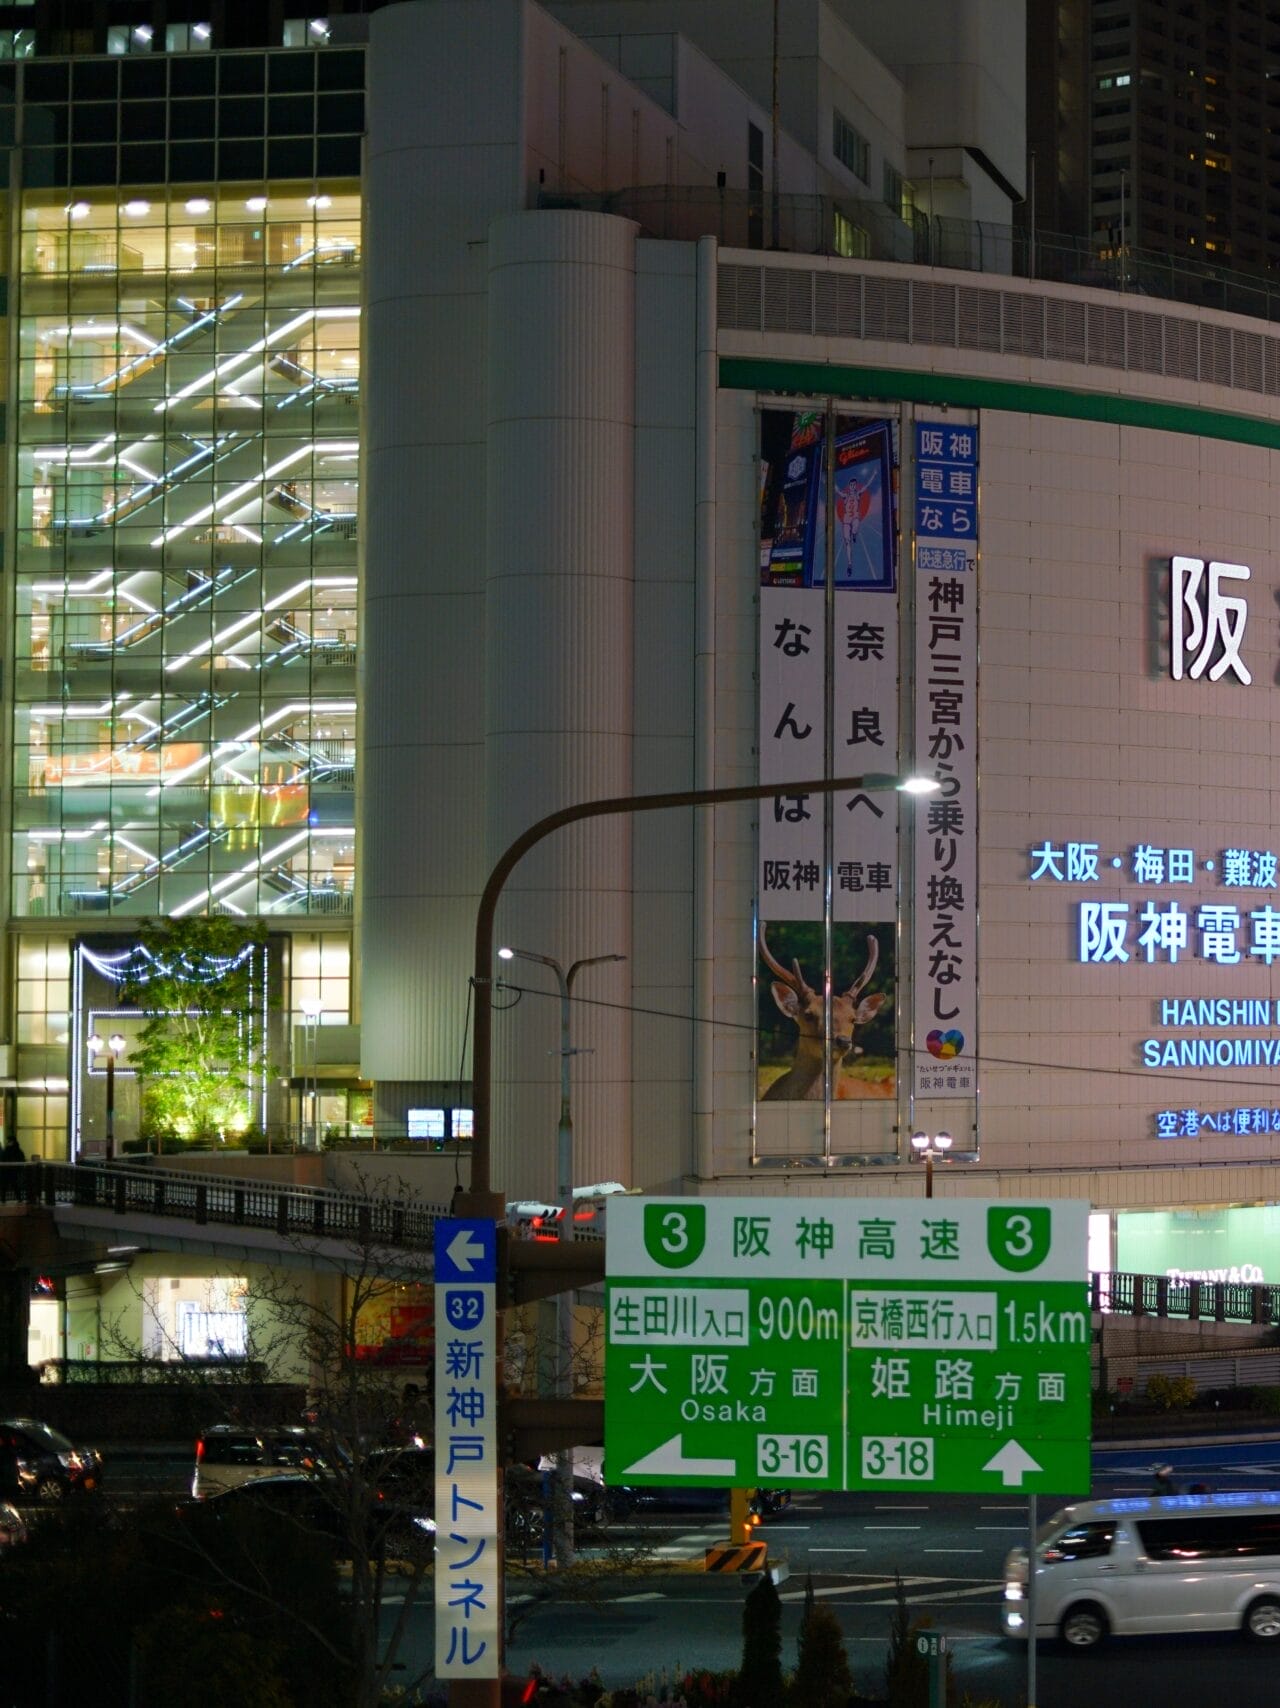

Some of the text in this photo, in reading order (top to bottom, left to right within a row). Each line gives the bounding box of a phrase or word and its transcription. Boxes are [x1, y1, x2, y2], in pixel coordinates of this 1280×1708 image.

[920, 430, 973, 459] 阪神
[920, 467, 973, 495] 電車
[920, 506, 971, 532] なら
[1162, 999, 1271, 1026] HANSHIN
[920, 1077, 970, 1089] 阪神電車
[661, 1212, 689, 1253] 3
[732, 1216, 961, 1261] 阪神高速
[1005, 1214, 1034, 1256] 3
[452, 1298, 479, 1319] 32
[613, 1294, 745, 1338] 生田川入口
[758, 1296, 839, 1341] 900m
[855, 1297, 993, 1342] 京橋西行入口
[1003, 1300, 1087, 1344] 1.5km
[629, 1353, 819, 1398] 大阪方面
[871, 1357, 1066, 1402] 姫路方面
[681, 1400, 767, 1422] Osaka
[922, 1403, 1014, 1430] Himeji
[761, 1438, 824, 1474] 3-16
[866, 1440, 929, 1475] 3-18
[446, 1339, 487, 1666] 新神戸トンネル
